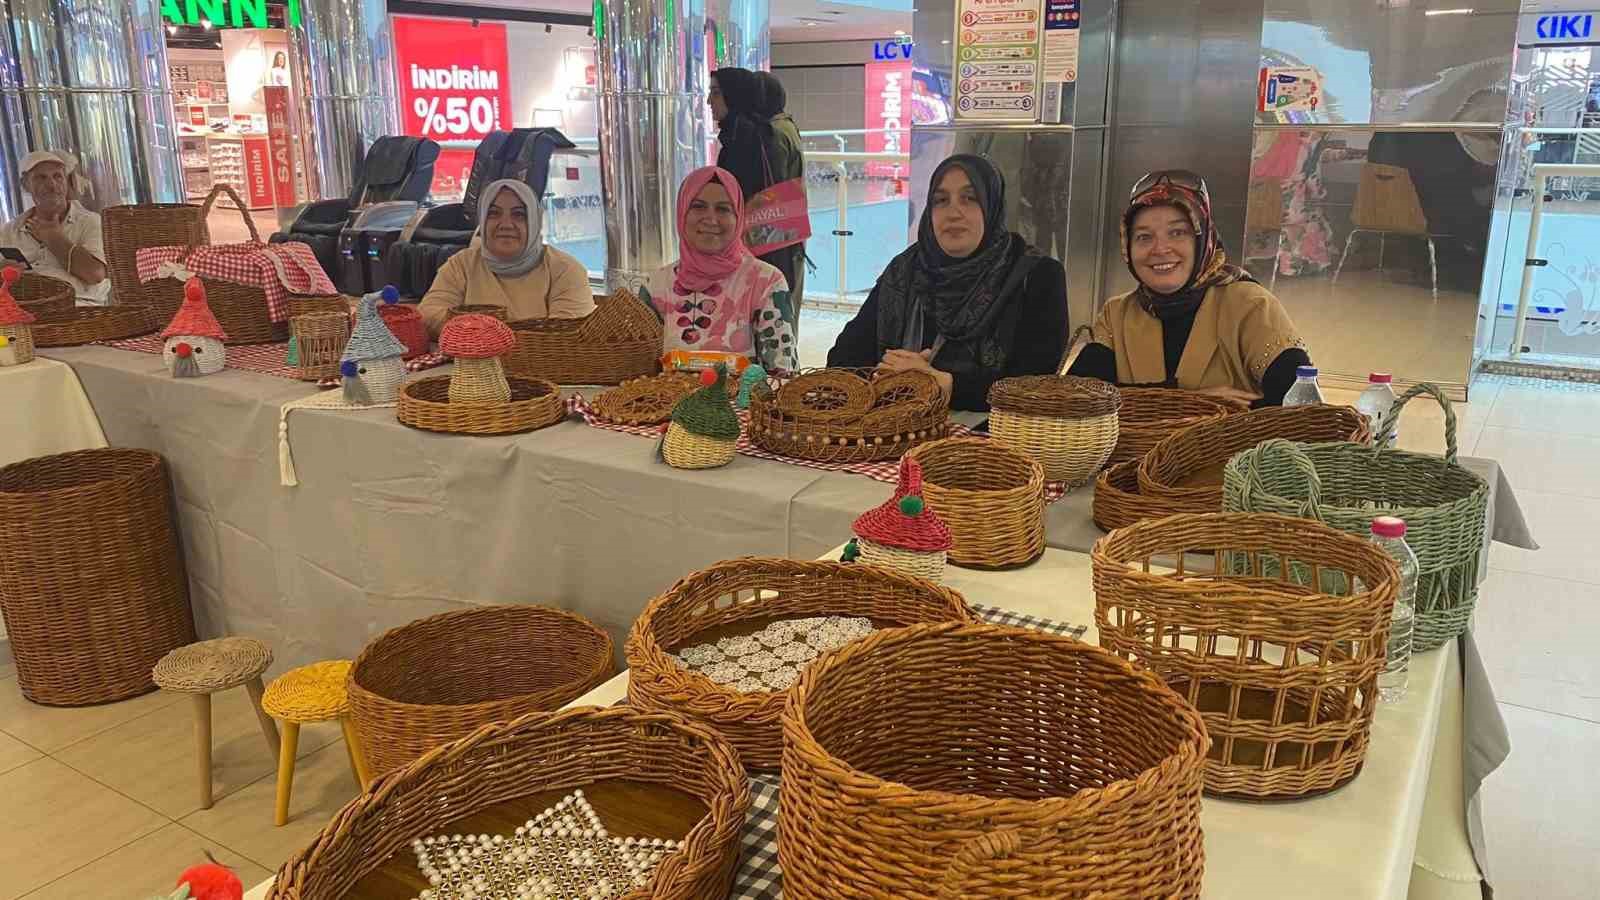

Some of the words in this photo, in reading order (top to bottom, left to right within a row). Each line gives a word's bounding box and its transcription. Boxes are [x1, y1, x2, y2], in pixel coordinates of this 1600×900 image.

[874, 42, 897, 59] LC
[411, 64, 498, 90] İNDİRİM
[414, 96, 494, 135] %50
